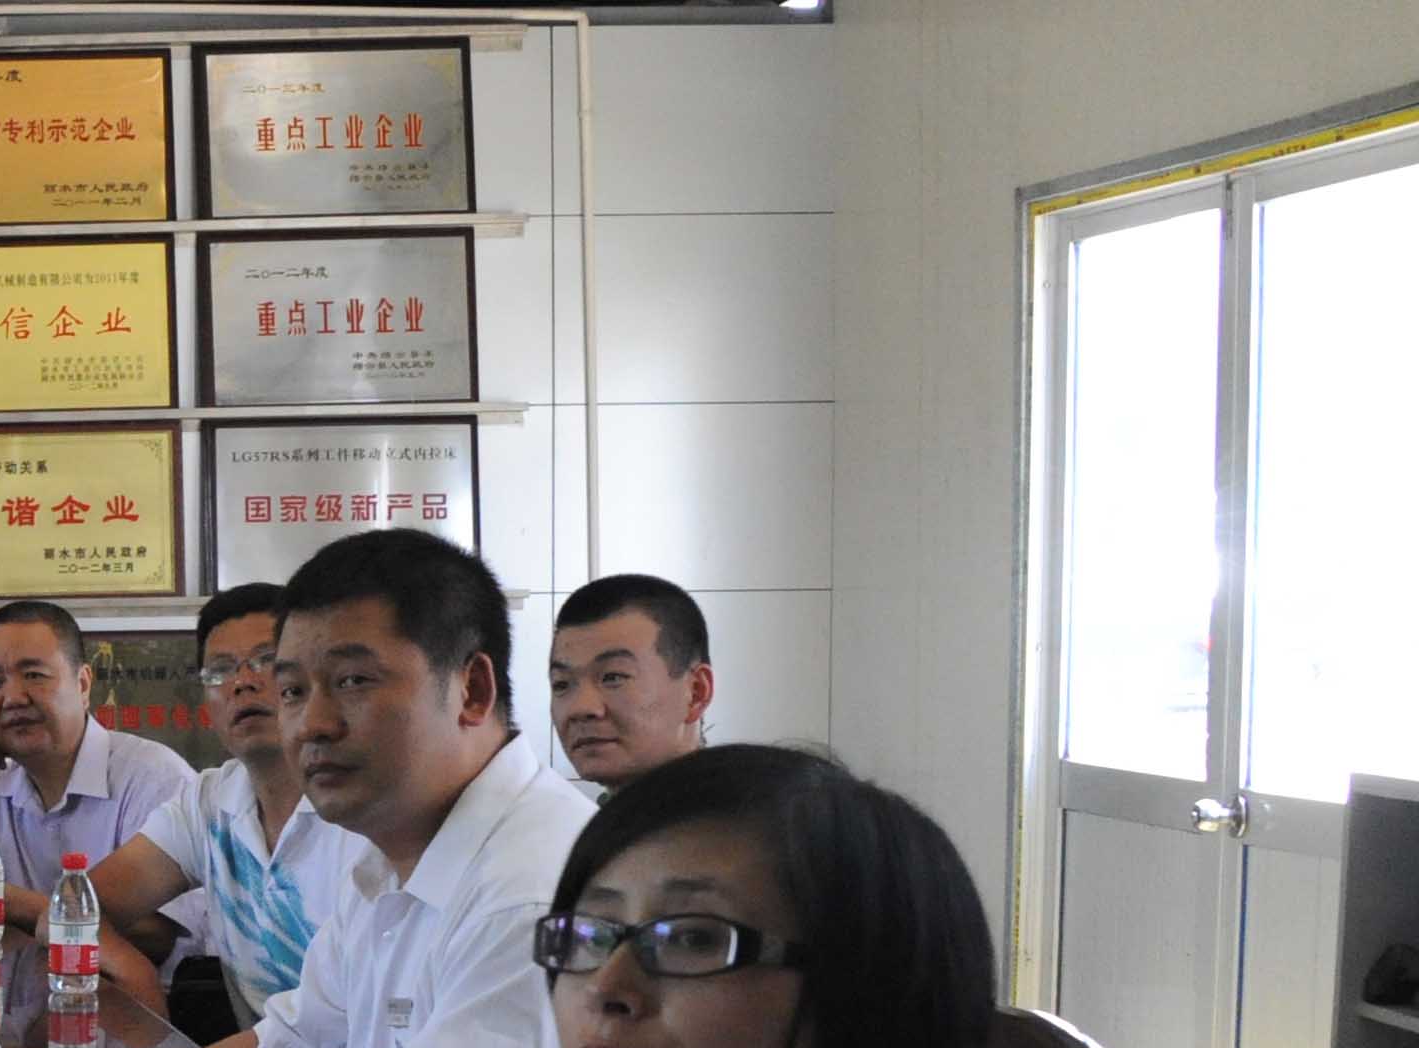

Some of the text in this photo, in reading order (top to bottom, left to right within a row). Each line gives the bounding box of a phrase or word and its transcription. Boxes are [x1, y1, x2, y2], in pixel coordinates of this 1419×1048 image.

[256, 112, 425, 152] 重点工业企业
[257, 297, 425, 337] 重点工业企业
[244, 492, 448, 524] 国家级新产品
[44, 545, 148, 561] 丽水市人民政府
